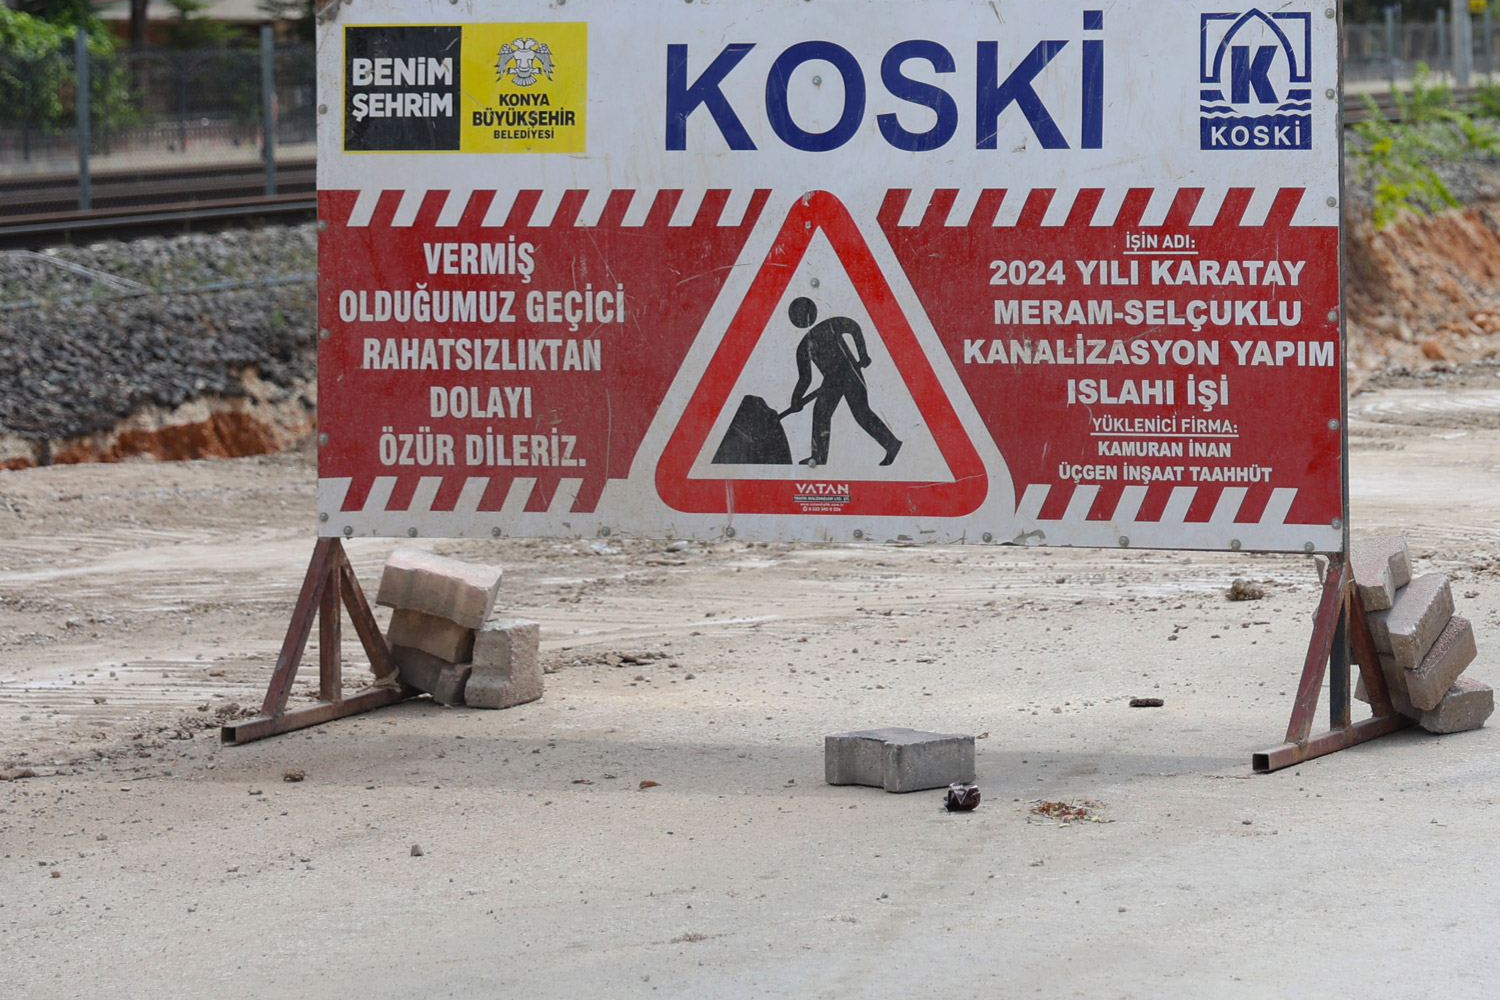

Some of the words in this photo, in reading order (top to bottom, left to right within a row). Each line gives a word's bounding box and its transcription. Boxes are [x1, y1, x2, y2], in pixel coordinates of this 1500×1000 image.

[666, 10, 1104, 152] KOSKİ
[499, 94, 550, 106] KONYA
[472, 107, 576, 128] BÜYÜKŞEHİR
[493, 128, 555, 139] BELEDİYESİ
[1212, 121, 1300, 146] KOSKİ
[1126, 231, 1158, 251] İŞİN
[1163, 234, 1196, 249] ADI:
[424, 235, 534, 283] VERMİŞ
[990, 260, 1065, 285] 2024
[1075, 260, 1138, 285] YILI
[1152, 260, 1306, 286] KARATAY
[339, 282, 516, 323] OLDUĞUMUZ
[526, 283, 625, 331] GEÇİCİ
[995, 300, 1301, 332] MERAM-SELÇUKLU
[363, 338, 601, 370] RAHATSIZLIKTAN
[964, 334, 1219, 365] KANALİZASYON
[1231, 340, 1335, 367] YAPIM
[431, 386, 531, 418] DOLAYI
[1067, 379, 1175, 405] ISLAHI
[1188, 374, 1228, 412] İŞİ
[1092, 415, 1177, 434] YÜKLENİCİ
[1181, 416, 1238, 433] FİRMA:
[380, 427, 455, 466] ÖZÜR
[466, 427, 586, 466] DİLERİZ.
[1098, 441, 1183, 457] KAMURAN
[1188, 439, 1231, 458] İNAN
[1059, 462, 1117, 483] ÜÇGEN
[1124, 462, 1184, 484] İNŞAAT
[1189, 464, 1272, 482] TAAHHÜT
[796, 484, 848, 494] VATAN
